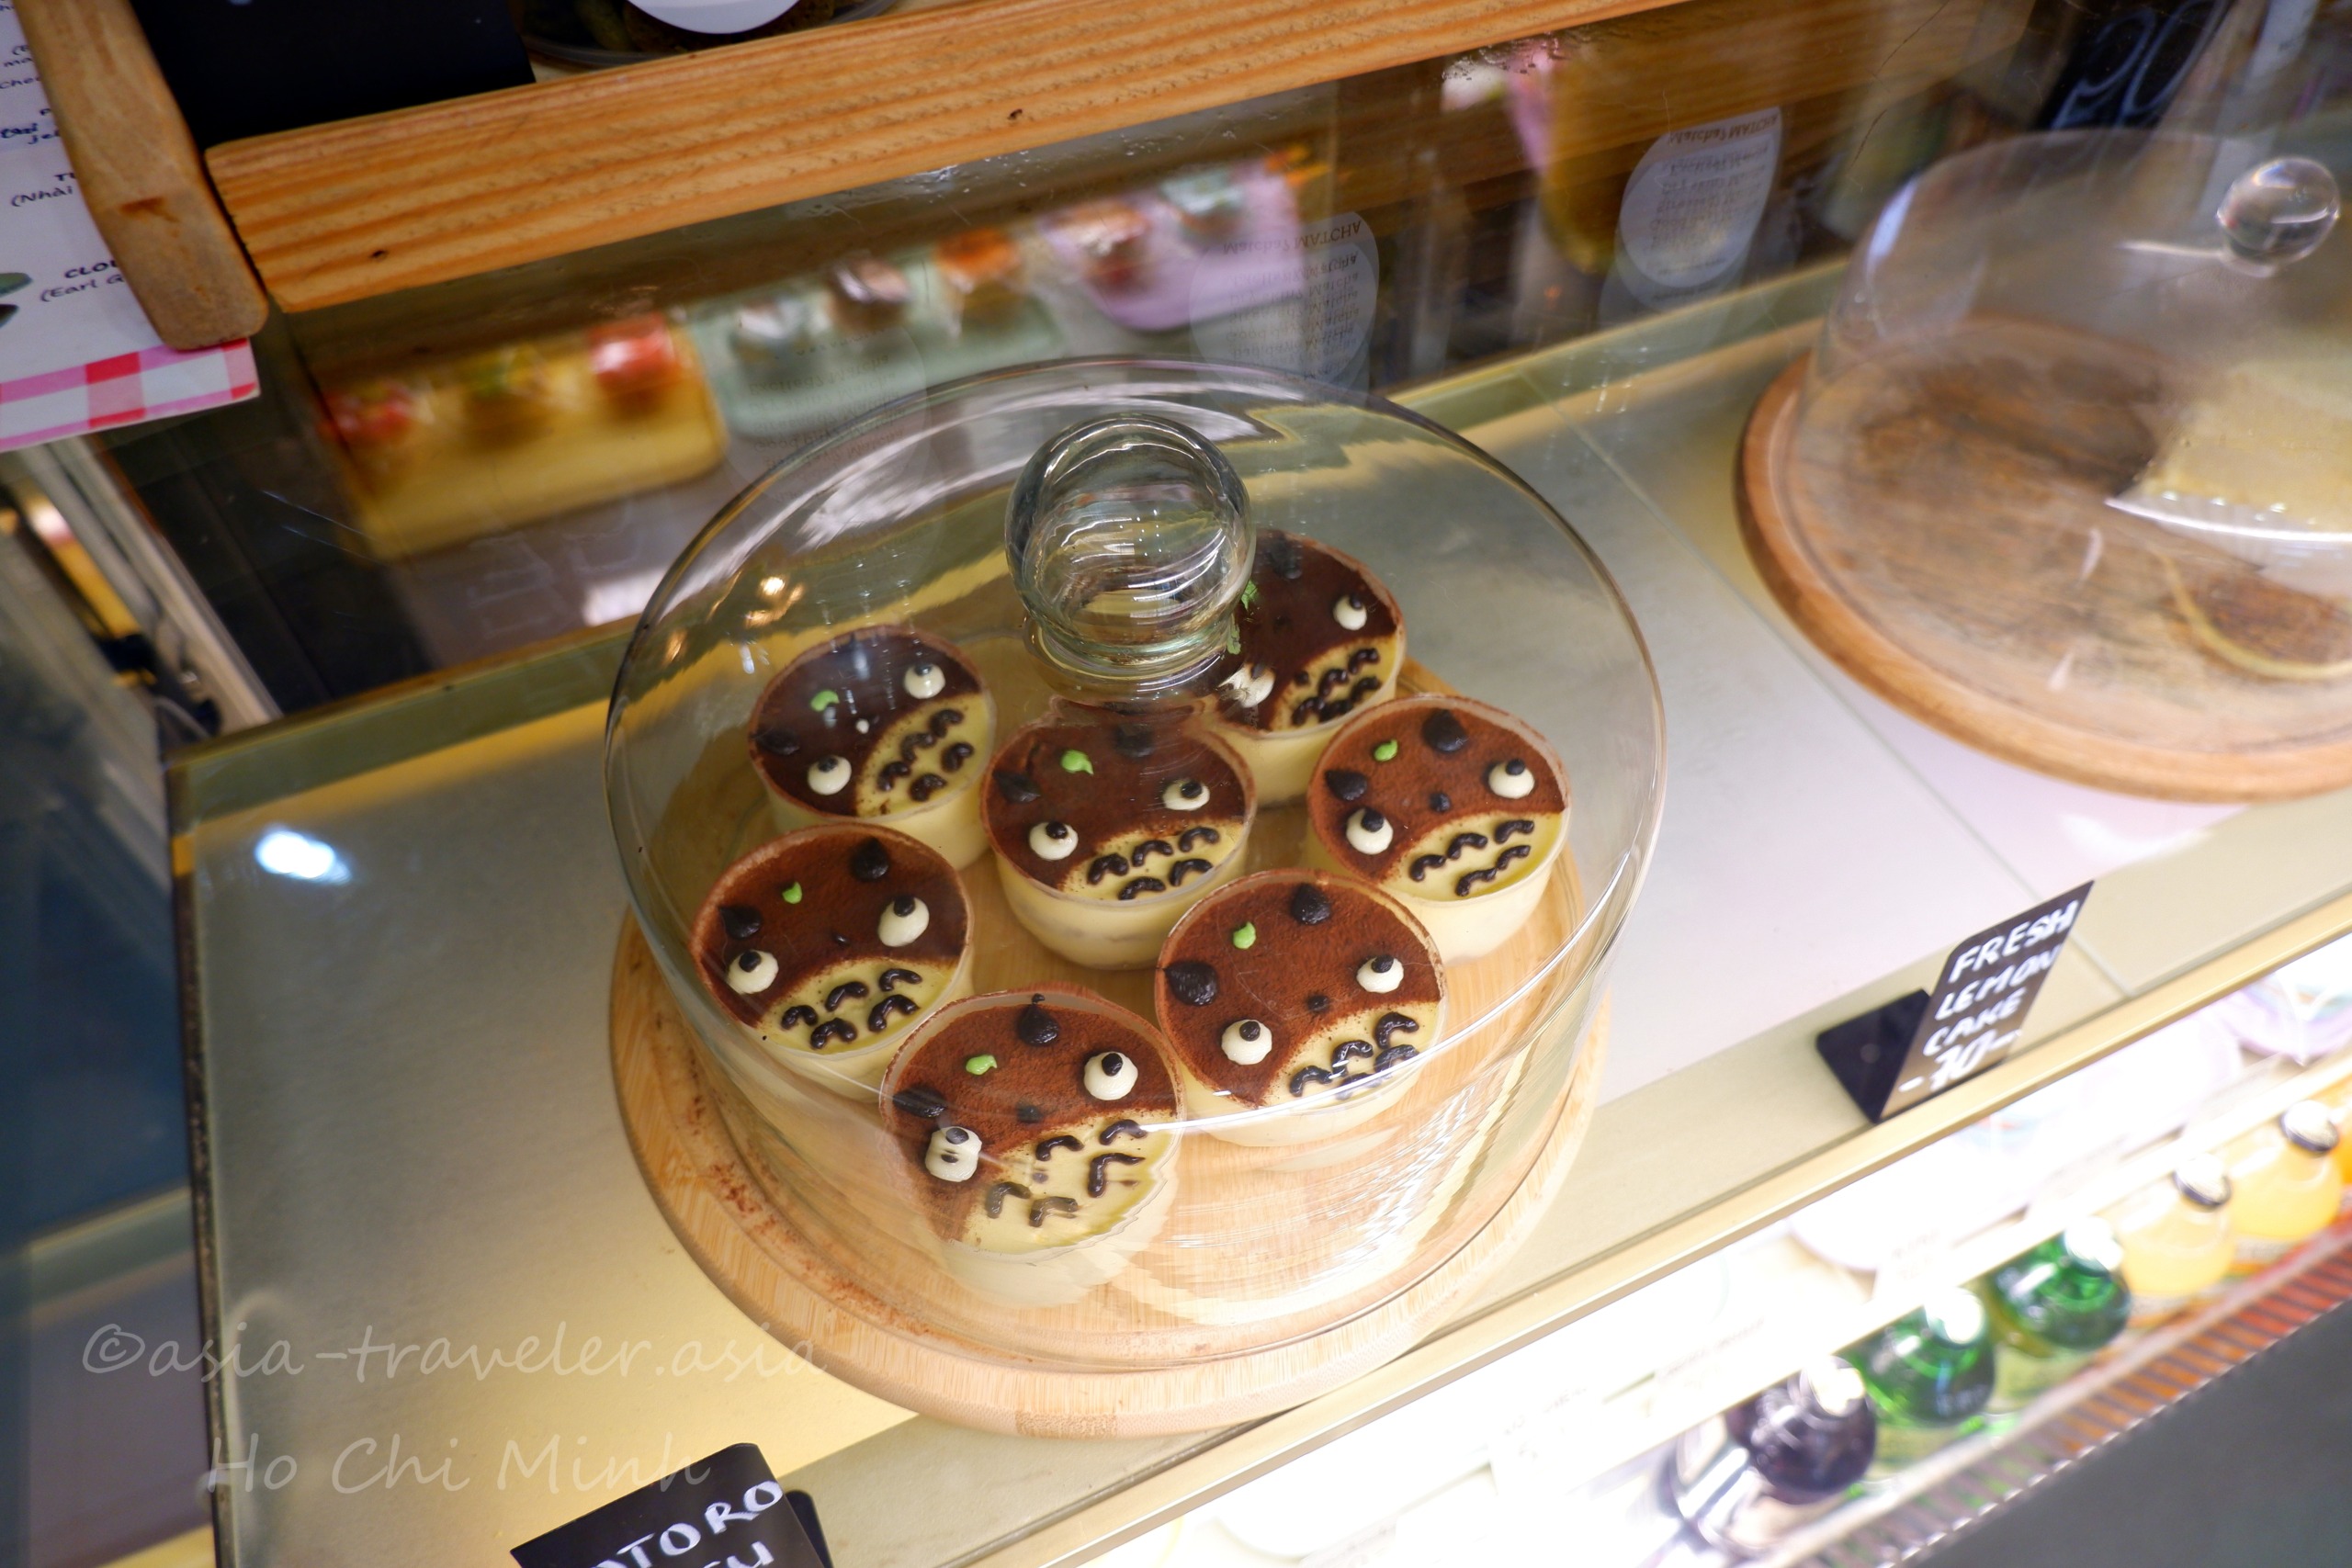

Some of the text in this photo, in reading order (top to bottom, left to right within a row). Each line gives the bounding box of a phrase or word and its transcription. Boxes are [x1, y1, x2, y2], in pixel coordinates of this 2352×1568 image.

[1948, 899, 2080, 984] FRESH
[1934, 942, 2064, 1021] LEMON
[1922, 987, 2027, 1057] CAKE
